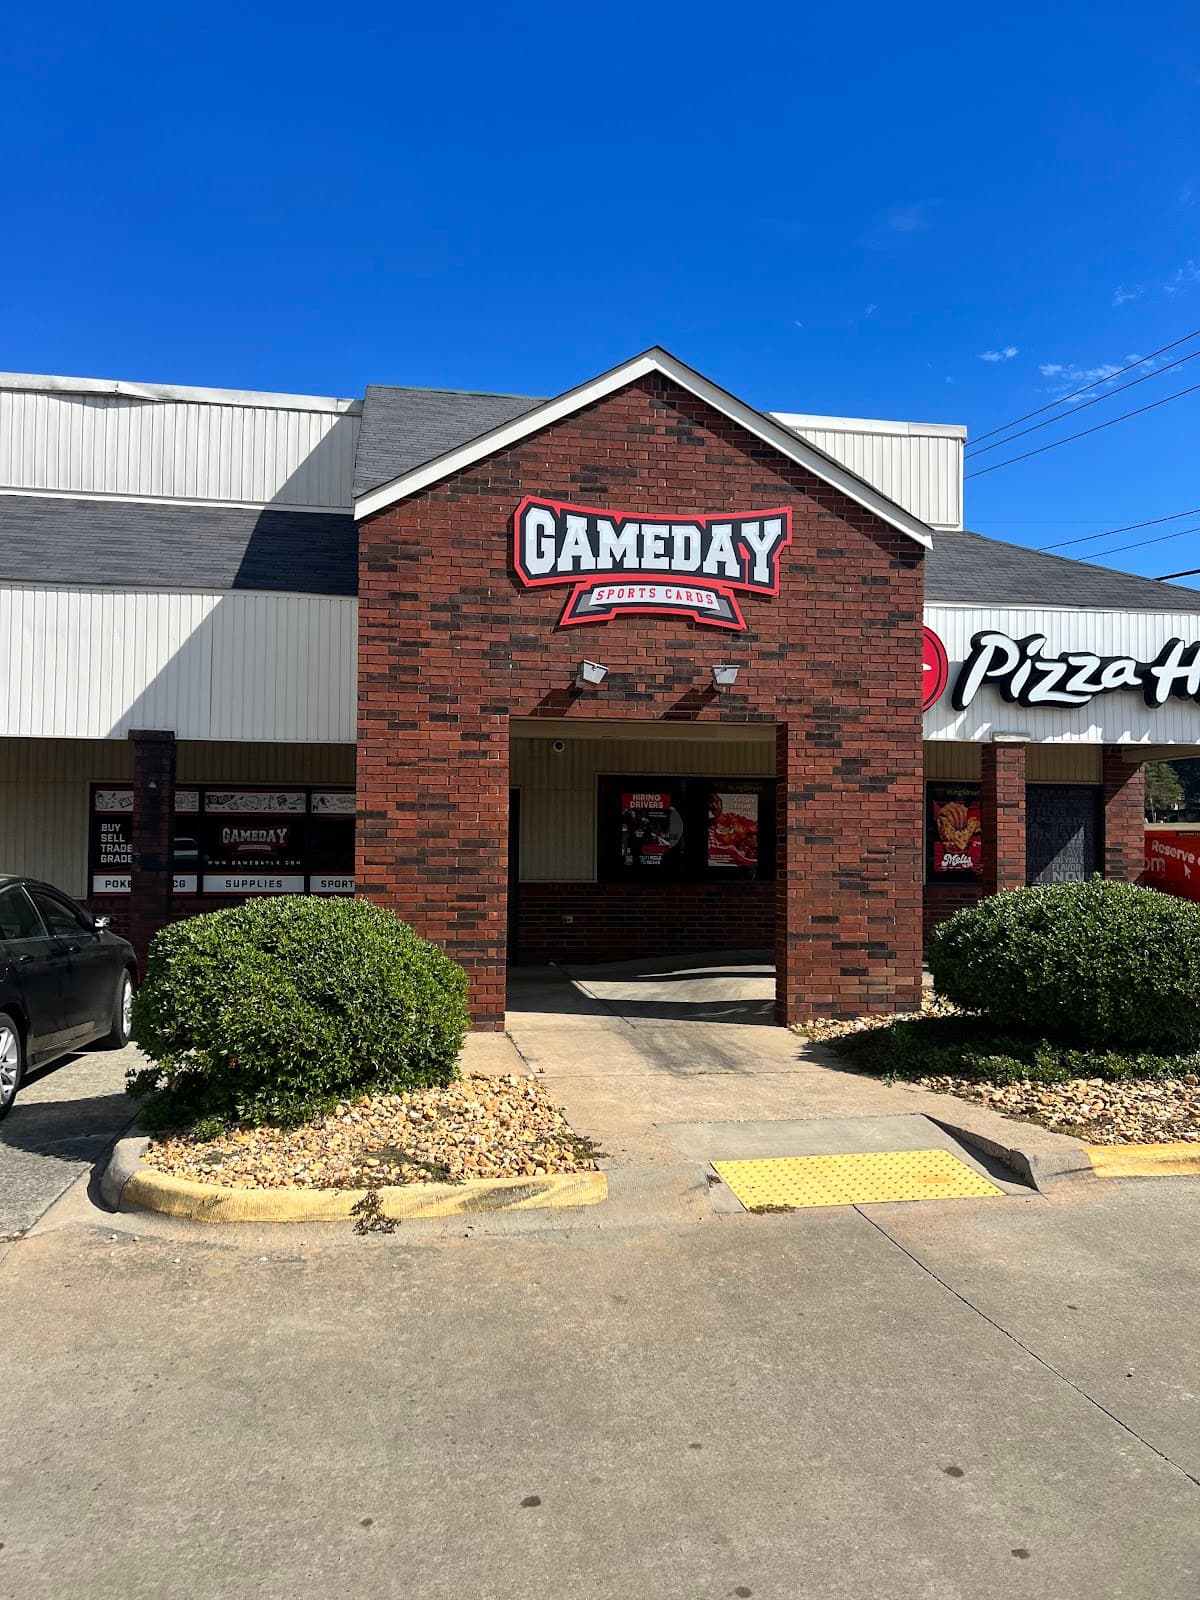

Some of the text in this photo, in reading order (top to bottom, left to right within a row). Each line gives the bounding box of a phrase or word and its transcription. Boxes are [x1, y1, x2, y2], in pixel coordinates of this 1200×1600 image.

[524, 507, 783, 584] GAMEDAY
[596, 587, 715, 605] SPORTS CARDS
[958, 632, 1200, 709] Pizza H
[633, 793, 662, 801] HIRING
[630, 801, 664, 809] DRIVERS
[100, 823, 121, 832] BUY
[100, 834, 125, 842] SELL
[222, 827, 288, 844] GAMEDAY
[100, 844, 133, 853] TRADE
[1152, 839, 1195, 864] Reserve
[100, 855, 133, 863] GRADE
[1052, 864, 1081, 872] FLAVOR
[105, 880, 186, 888] POKE CG
[225, 880, 283, 888] SUPPLIES
[320, 880, 355, 888] SPORT
